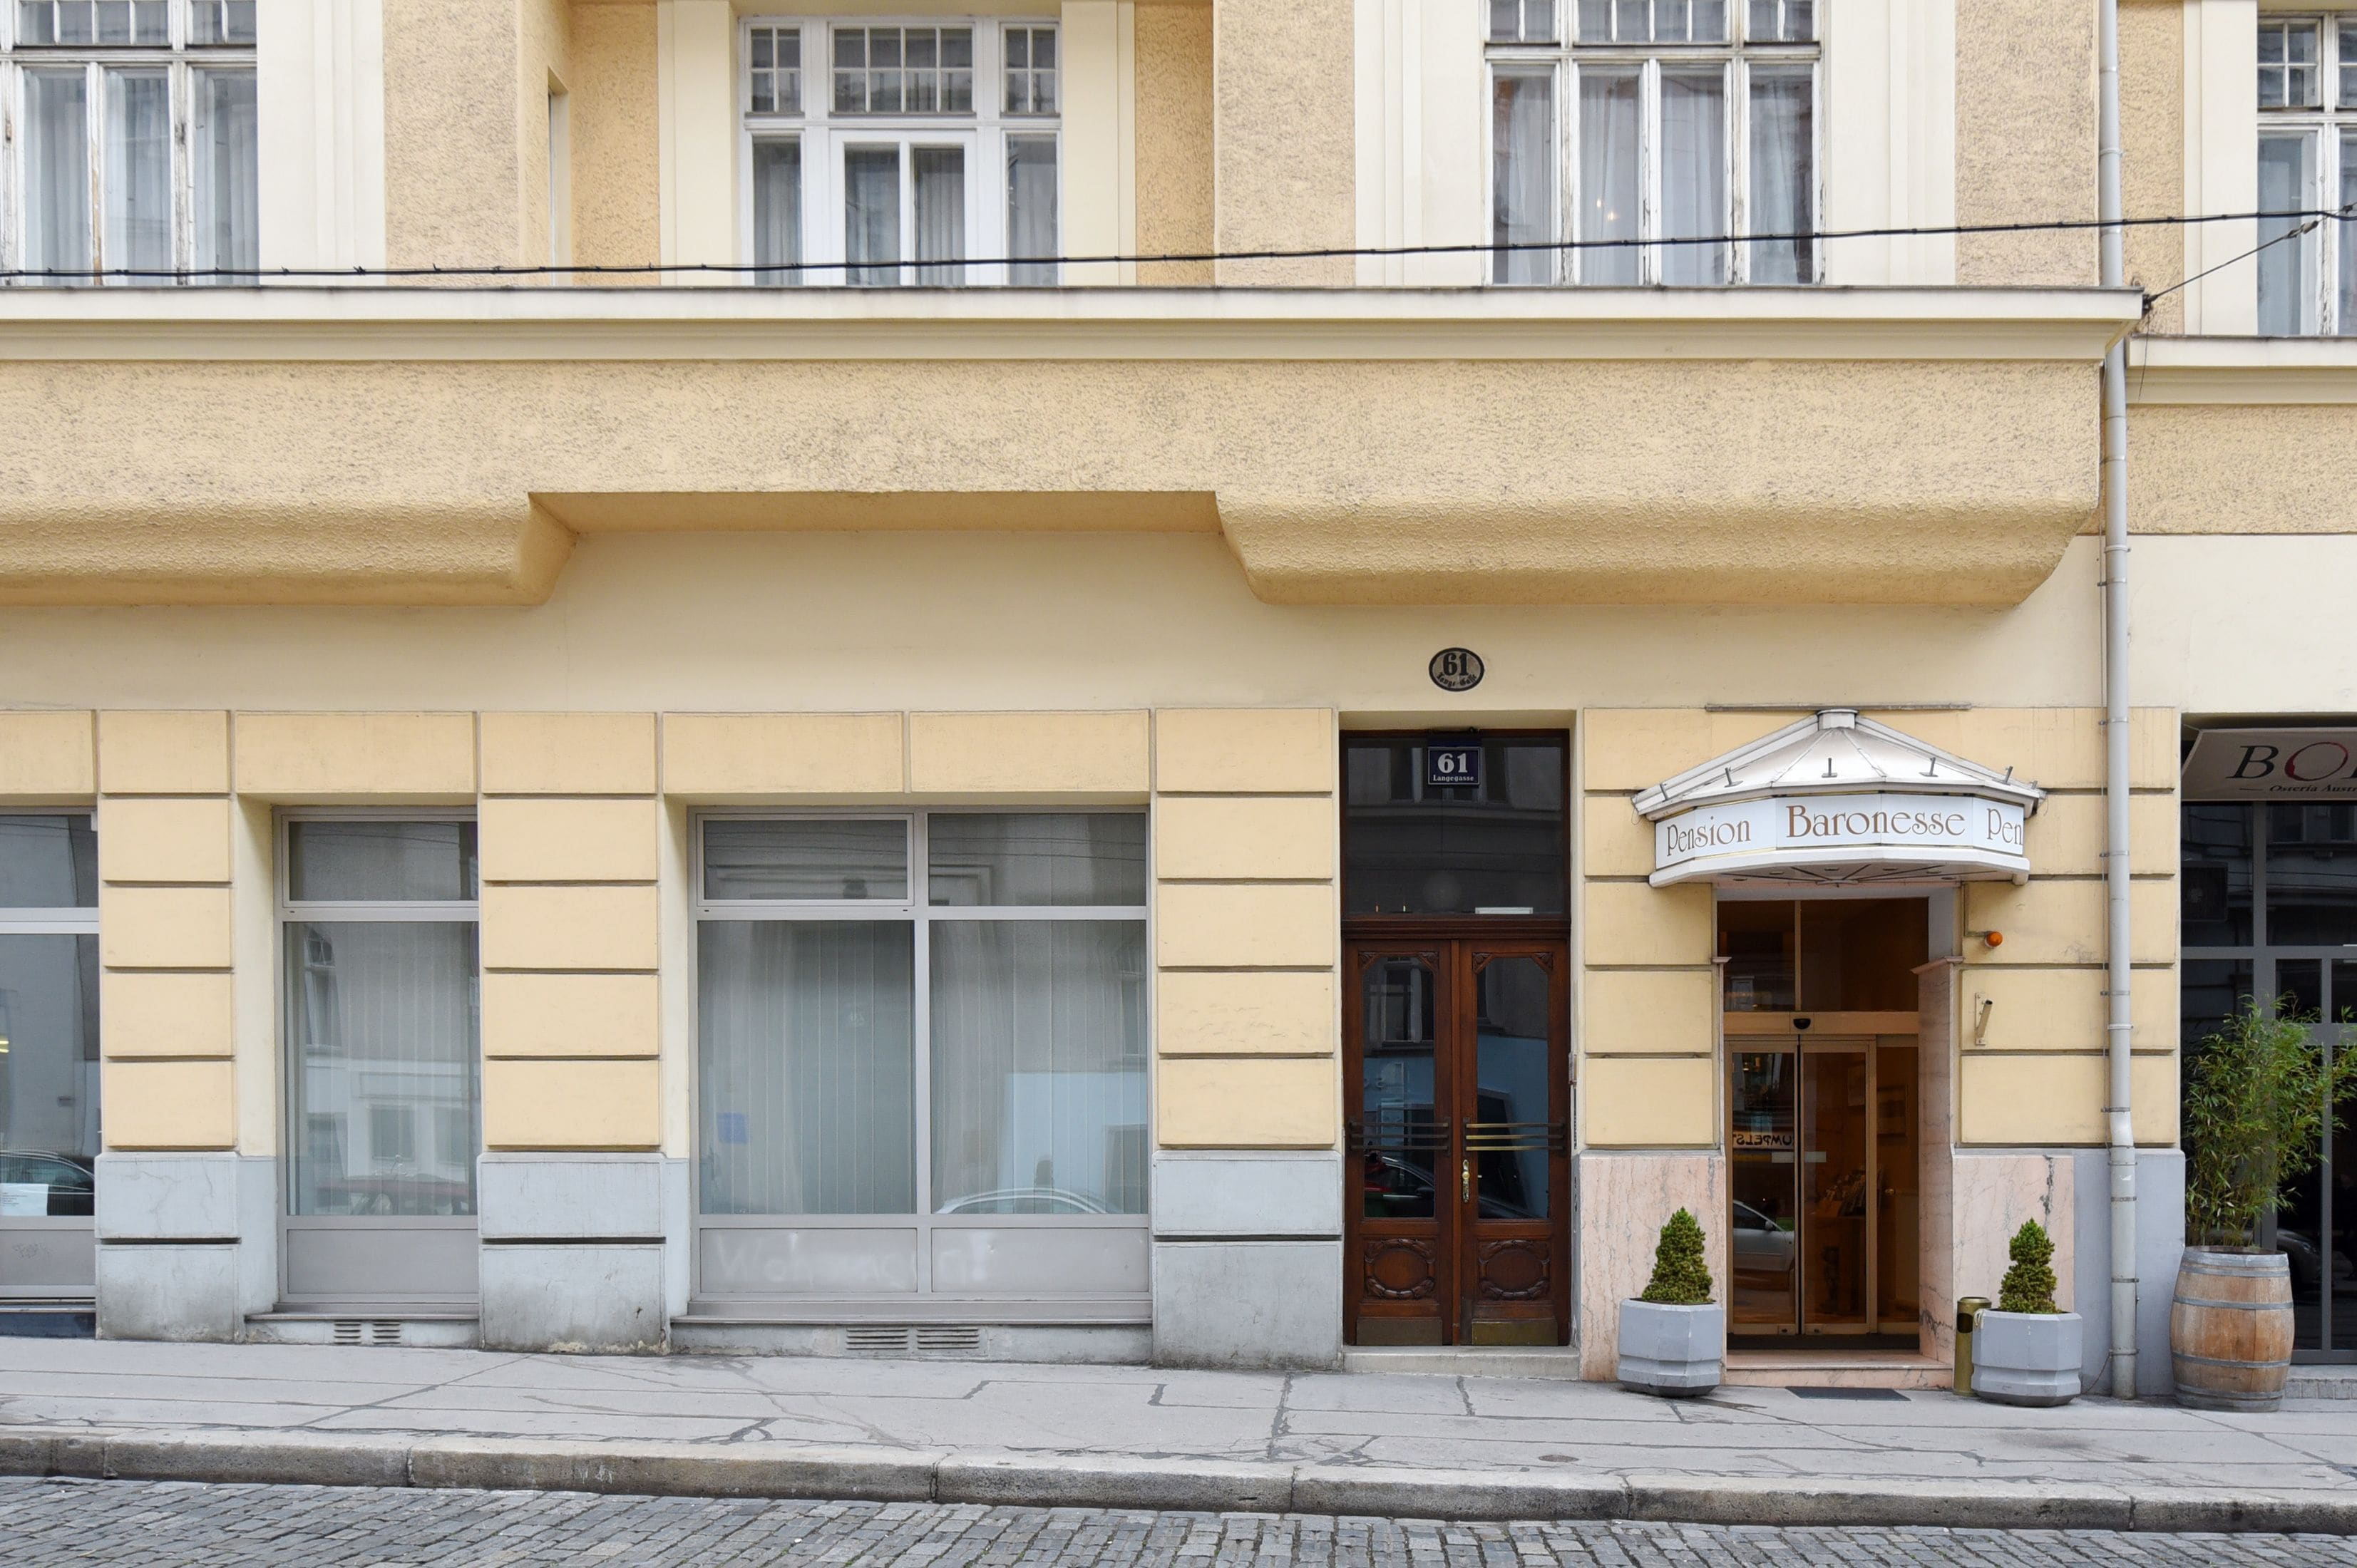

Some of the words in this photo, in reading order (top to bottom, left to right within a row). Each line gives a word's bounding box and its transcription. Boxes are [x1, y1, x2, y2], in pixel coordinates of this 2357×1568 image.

[1443, 653, 1469, 676] 61
[1437, 753, 1468, 773] 61
[2226, 742, 2357, 781] BO
[1667, 816, 1751, 856] Pension
[1786, 805, 1966, 837] Baronesse
[1986, 808, 2023, 845] Pen
